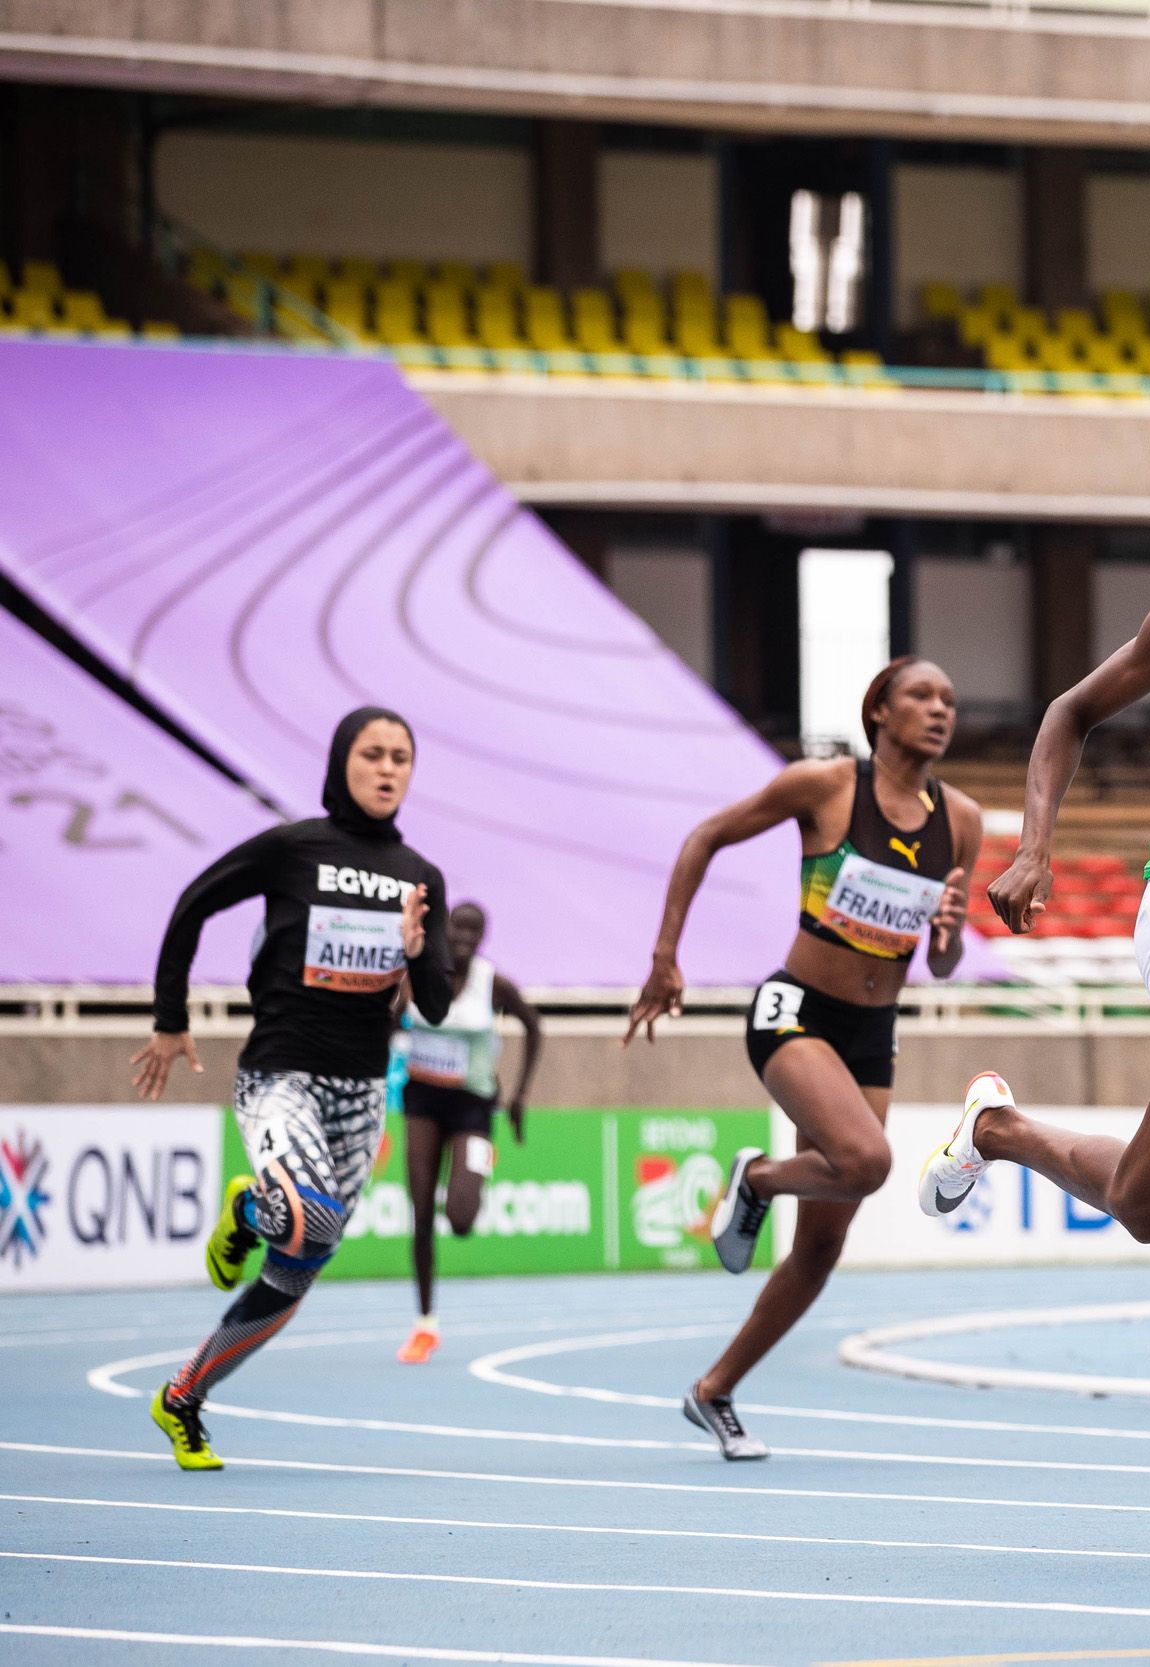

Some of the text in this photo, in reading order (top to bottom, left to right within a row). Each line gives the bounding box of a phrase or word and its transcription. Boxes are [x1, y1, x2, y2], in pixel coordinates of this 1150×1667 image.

[318, 863, 417, 907] EGYPT
[836, 886, 926, 931] FRANCIS
[767, 992, 783, 1022] 3
[259, 1128, 275, 1153] 4
[67, 1146, 204, 1247] QNB
